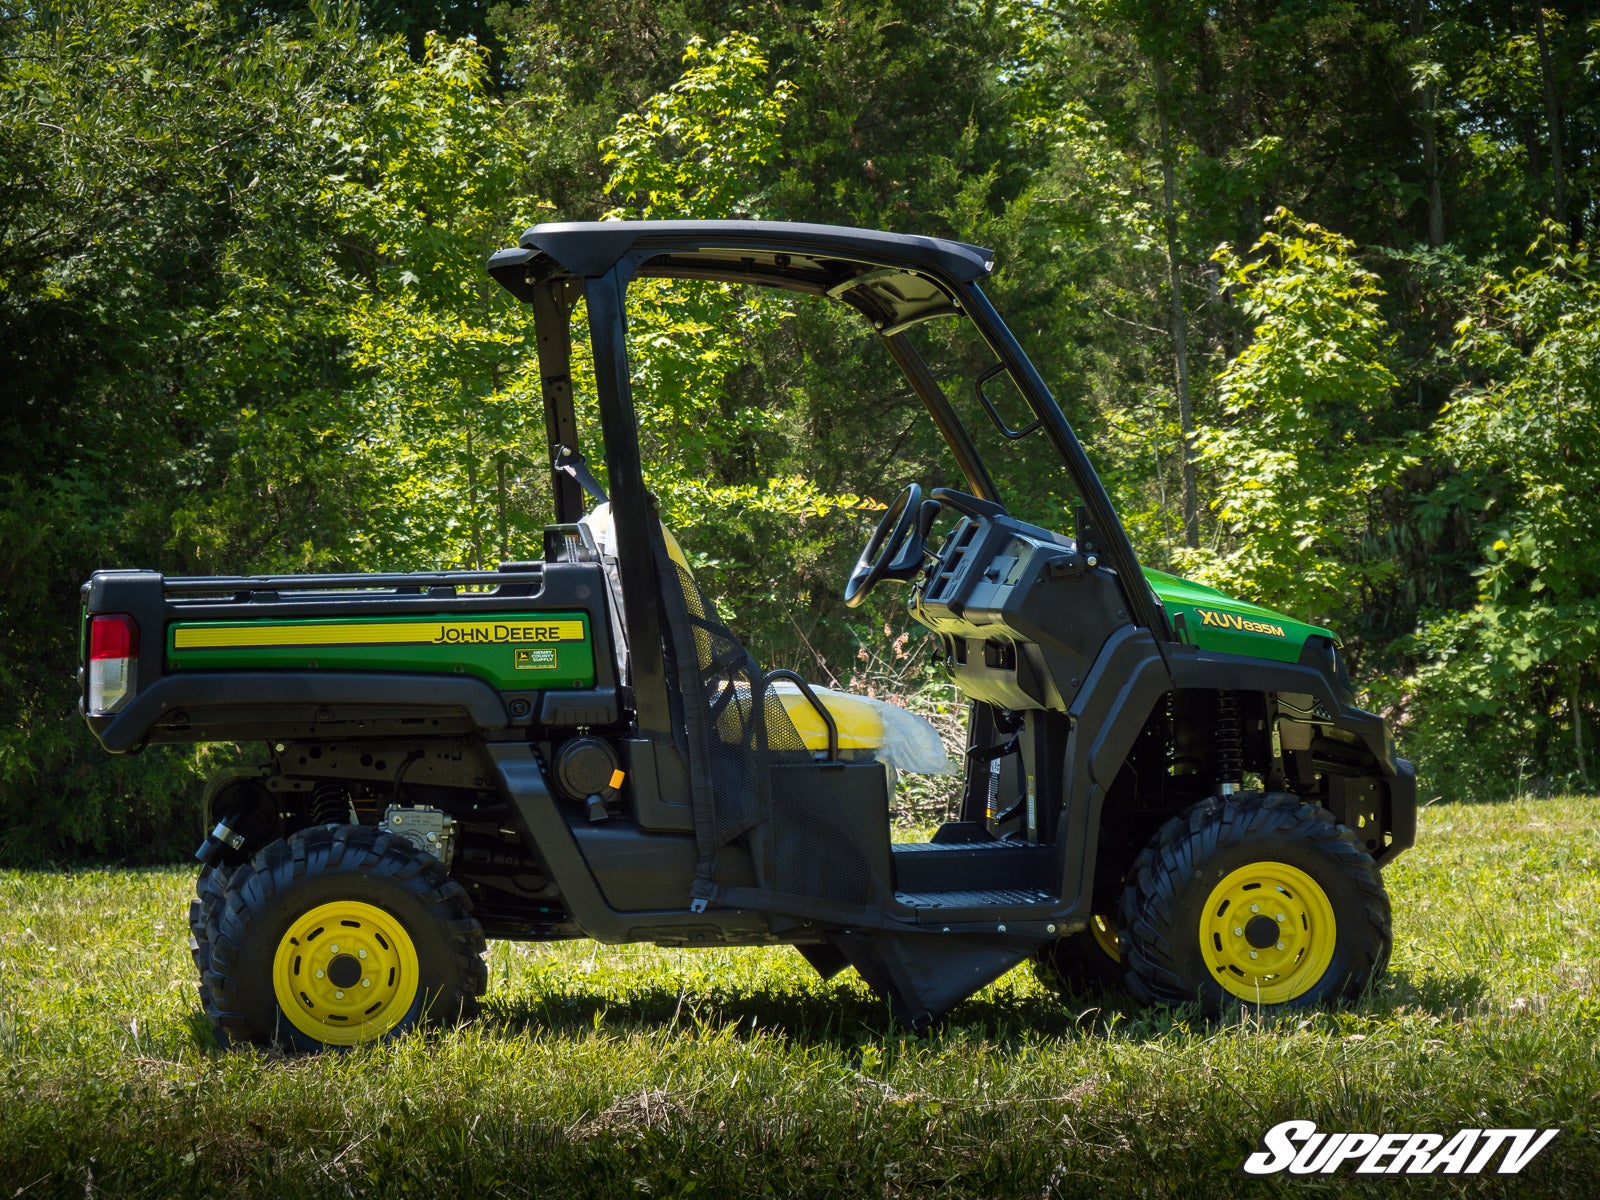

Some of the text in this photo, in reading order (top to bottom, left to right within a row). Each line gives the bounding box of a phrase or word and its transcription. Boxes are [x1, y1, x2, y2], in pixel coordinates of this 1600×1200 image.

[434, 625, 560, 641] JOHN DEERE
[1197, 609, 1285, 637] XUV835M
